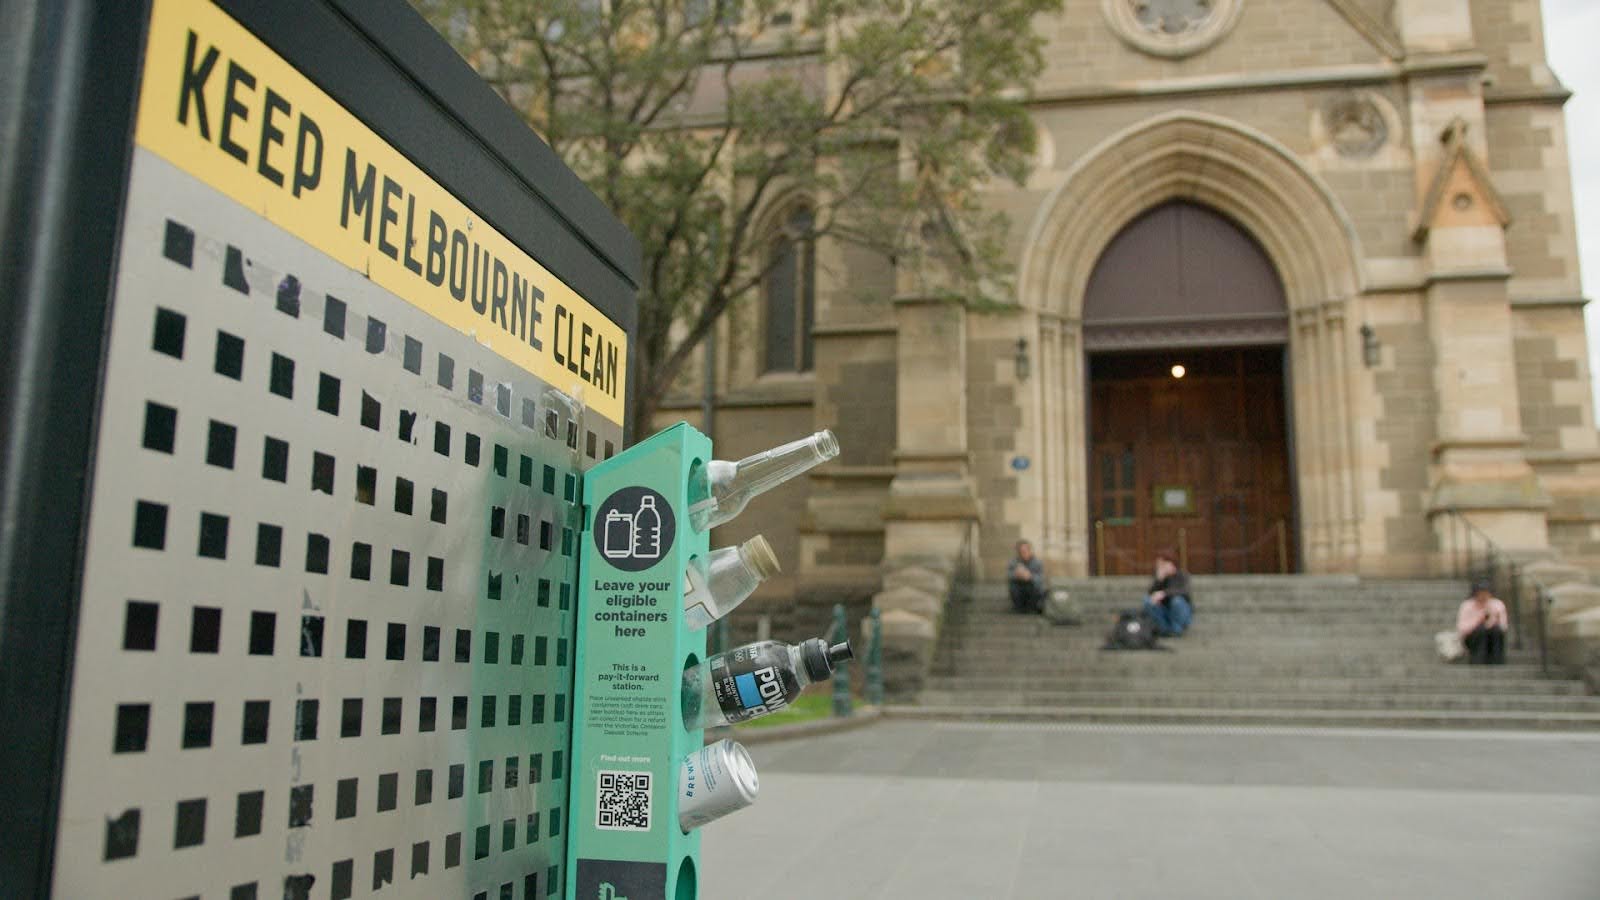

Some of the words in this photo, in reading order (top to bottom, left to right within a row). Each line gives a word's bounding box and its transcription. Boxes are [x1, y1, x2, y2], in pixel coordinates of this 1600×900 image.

[178, 27, 324, 200] KEEP
[340, 146, 545, 352] MELBOURNE
[553, 303, 618, 400] CLEAN
[594, 580, 635, 591] Leave
[639, 581, 671, 593] your
[606, 594, 658, 608] eligible
[594, 610, 668, 622] containers
[614, 625, 646, 637] here
[598, 673, 660, 682] pay-it-forward
[612, 682, 644, 690] station.
[754, 665, 787, 712] POW
[601, 754, 616, 762] Find
